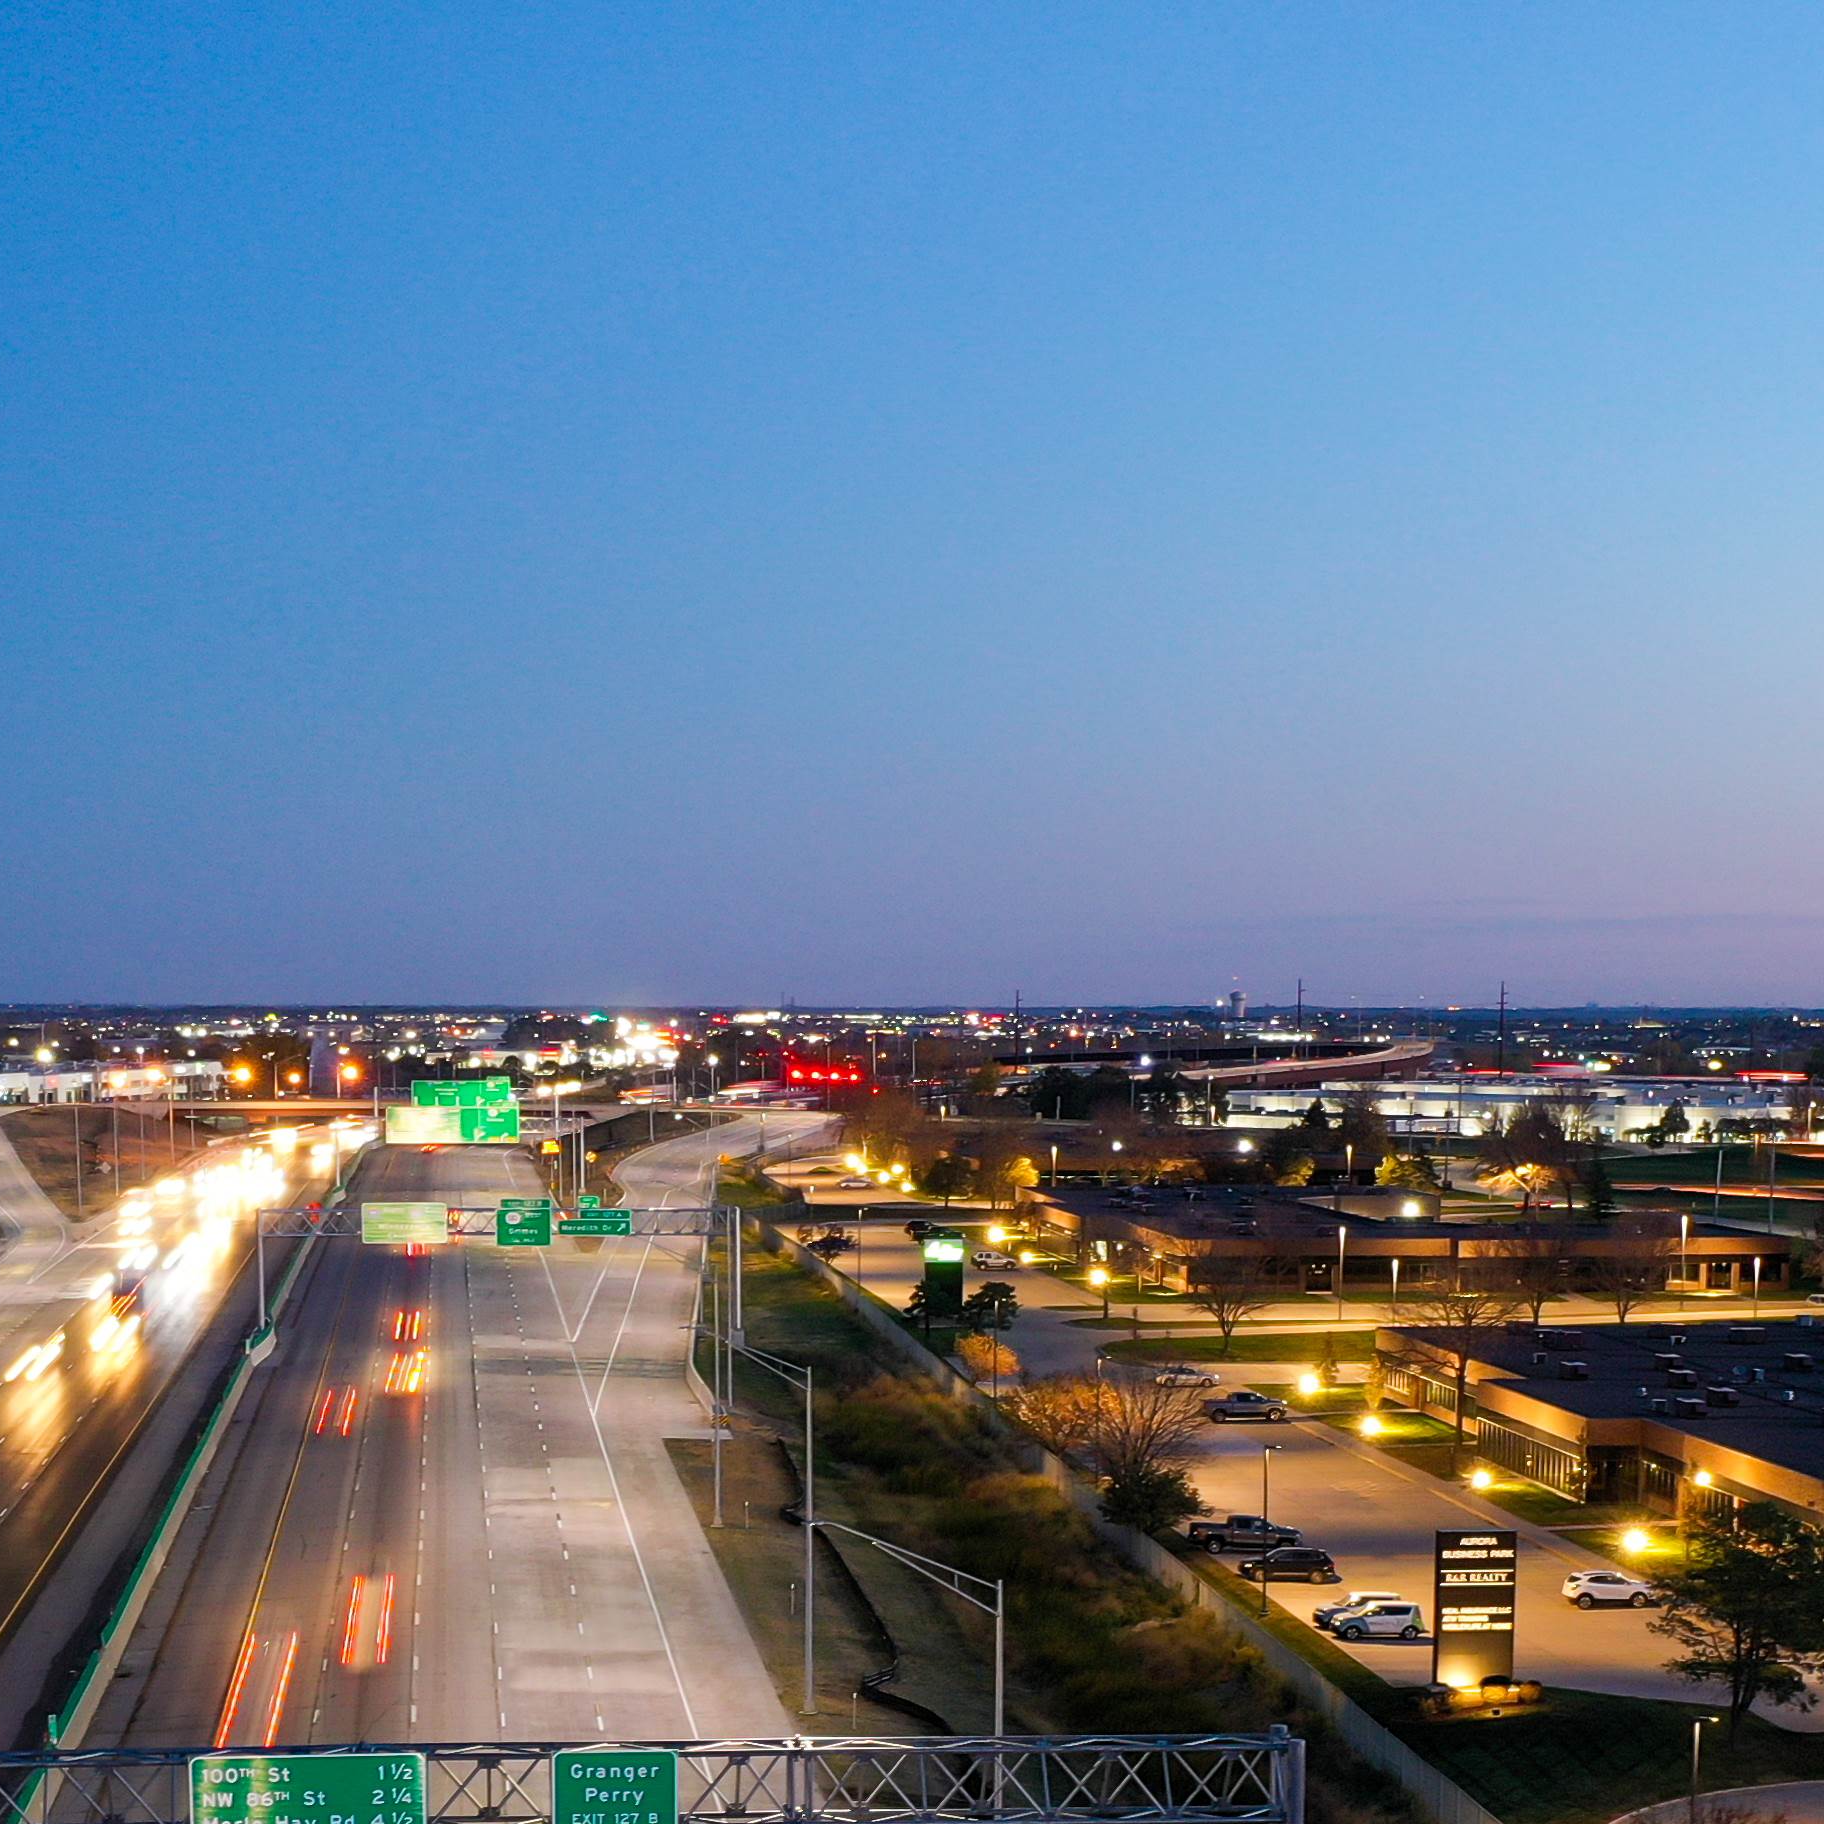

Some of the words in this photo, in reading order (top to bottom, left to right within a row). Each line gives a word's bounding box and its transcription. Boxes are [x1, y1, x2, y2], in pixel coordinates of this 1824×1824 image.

[1442, 1550, 1488, 1559] BUSINESS
[1490, 1550, 1514, 1558] PARK
[1469, 1573, 1507, 1582] REALTY
[268, 1768, 290, 1783] St
[570, 1763, 659, 1782] Granger
[202, 1792, 233, 1808] NW
[303, 1791, 325, 1806] St
[585, 1787, 644, 1806] Perry
[572, 1813, 606, 1824] EXIT
[614, 1812, 640, 1824] 127
[648, 1812, 658, 1824] B
